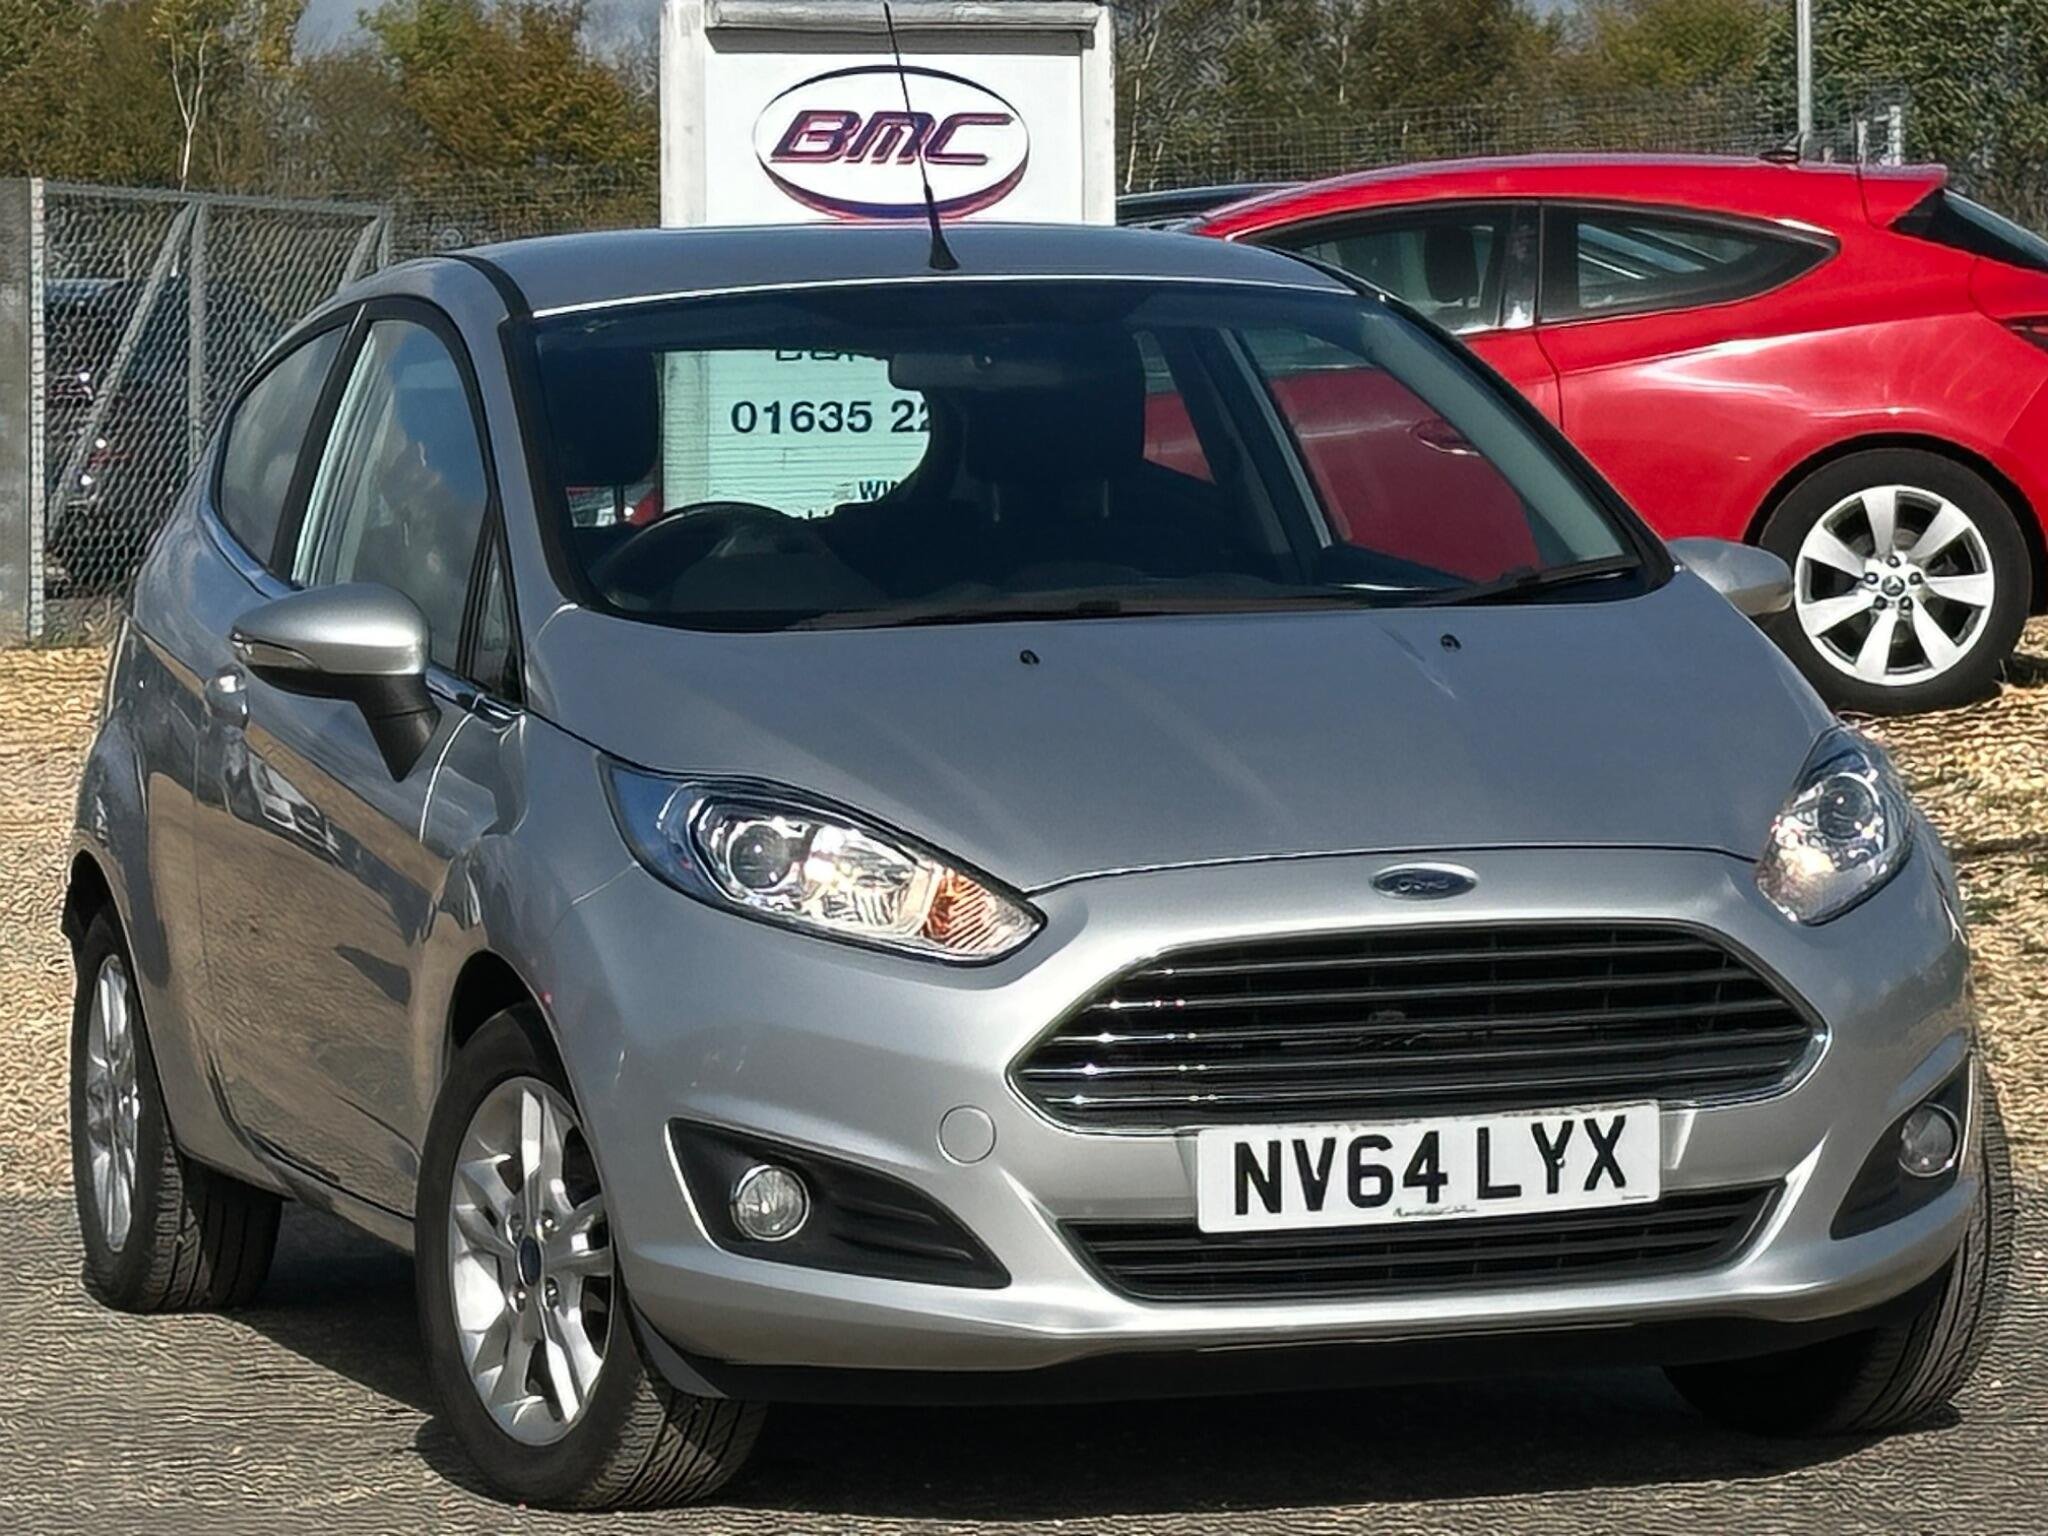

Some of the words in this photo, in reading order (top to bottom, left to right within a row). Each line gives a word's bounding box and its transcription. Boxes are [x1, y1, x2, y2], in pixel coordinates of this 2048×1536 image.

[769, 110, 1015, 165] BMC
[731, 401, 872, 433] 01635
[1235, 1131, 1448, 1215] NV64
[1477, 1115, 1626, 1200] LYX
